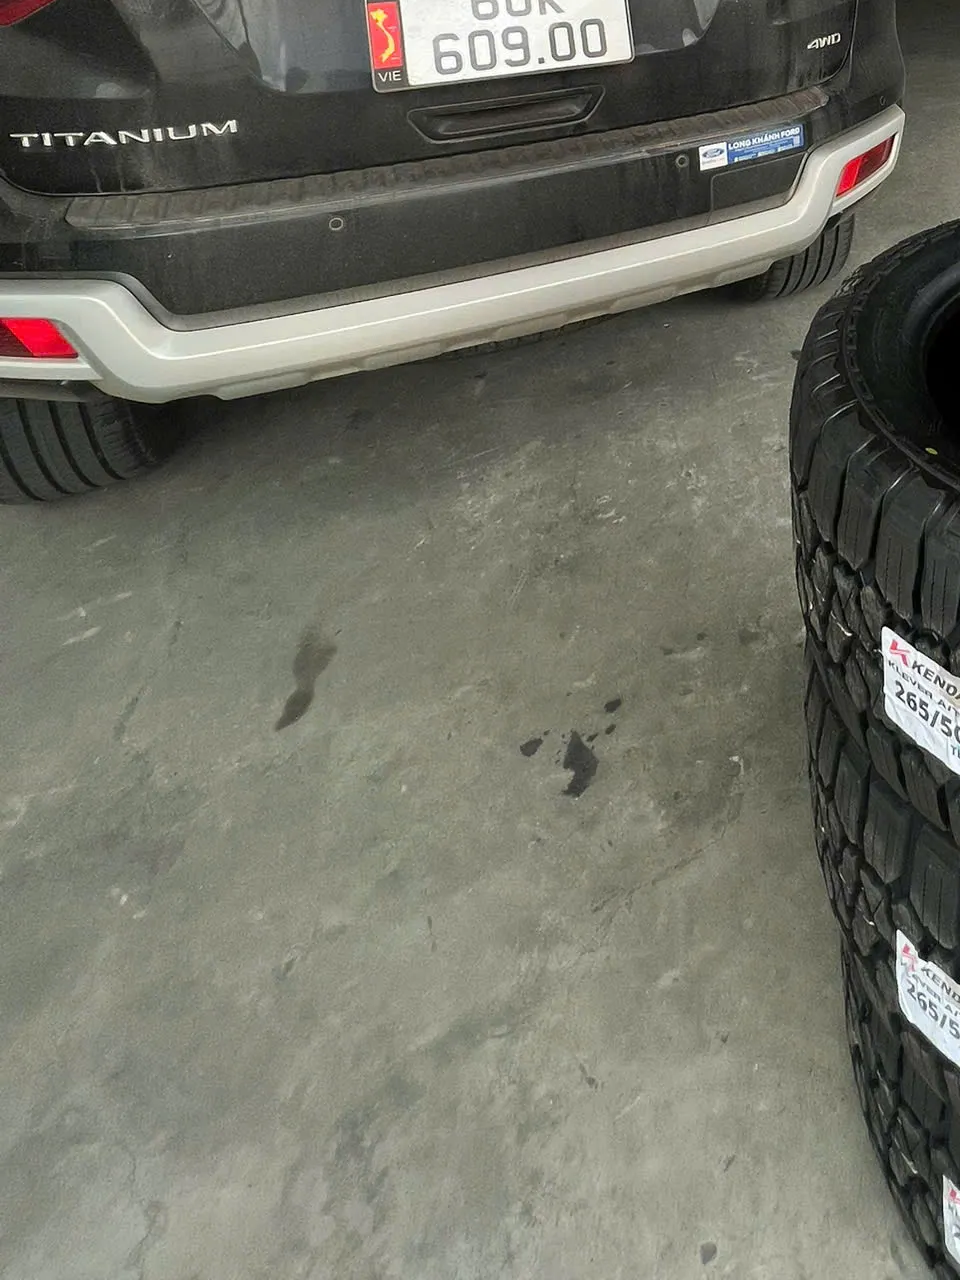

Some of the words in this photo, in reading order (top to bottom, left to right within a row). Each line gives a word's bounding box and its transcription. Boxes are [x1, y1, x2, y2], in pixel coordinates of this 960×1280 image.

[433, 18, 607, 75] 609.00
[807, 32, 842, 51] 4WD
[378, 70, 401, 82] VIE
[10, 120, 240, 147] TITANIUM
[728, 140, 751, 150] LONG
[752, 131, 780, 145] KHÁNH
[781, 127, 800, 138] FORD
[888, 660, 932, 699] KLEVER
